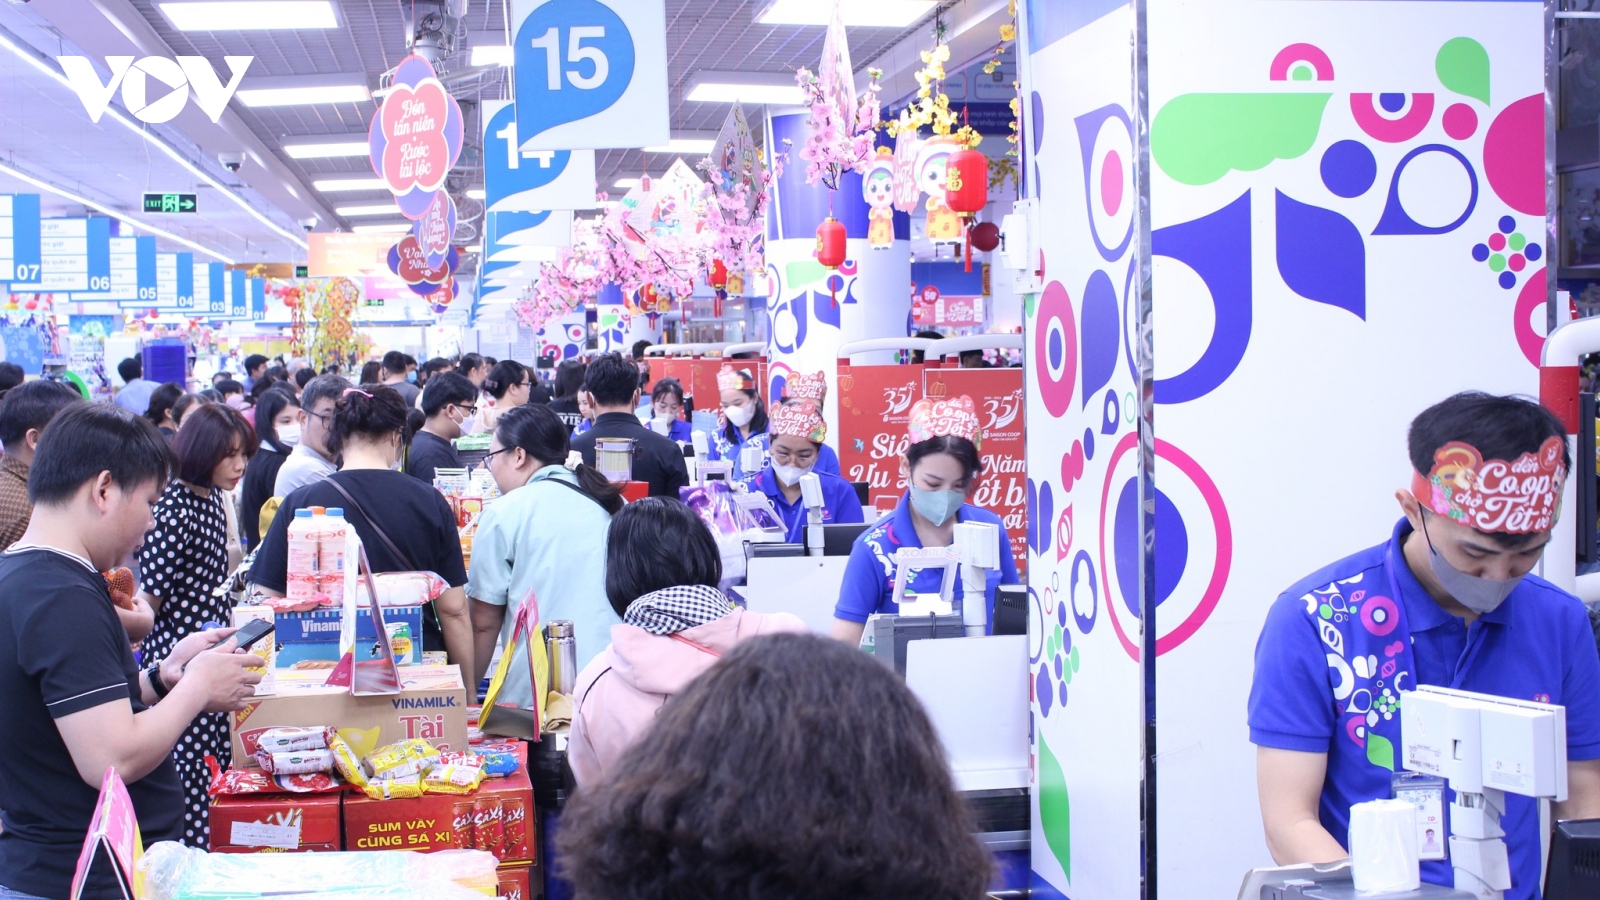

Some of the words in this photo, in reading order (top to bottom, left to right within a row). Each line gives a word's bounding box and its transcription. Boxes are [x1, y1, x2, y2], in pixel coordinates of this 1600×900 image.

[531, 25, 609, 91] 15
[401, 98, 425, 120] Đón
[412, 115, 435, 133] niên
[400, 141, 430, 161] Rước
[399, 160, 413, 178] tài
[414, 159, 432, 179] lộc
[145, 199, 161, 208] EXIT
[16, 264, 40, 280] 07
[90, 276, 110, 290] 06
[139, 287, 157, 299] 05
[178, 296, 194, 307] 04
[211, 302, 225, 312] 03
[233, 306, 246, 315] 02
[253, 311, 264, 320] 01
[778, 405, 809, 426] Co.op
[931, 402, 970, 424] Co.op
[981, 395, 1020, 430] 35
[777, 419, 803, 436] Tết
[934, 417, 967, 436] Tết
[973, 474, 1002, 507] ết
[1004, 477, 1026, 507] b
[1478, 462, 1550, 507] Co.op
[1476, 495, 1540, 531] Tết
[301, 619, 343, 634] Vinami
[391, 695, 456, 710] VINAMILK
[398, 714, 445, 740] Tài
[503, 806, 525, 825] áXị
[368, 821, 402, 834] SUM
[356, 834, 403, 850] CÙNG
[407, 831, 431, 845] SÁ
[434, 831, 452, 844] XỊ
